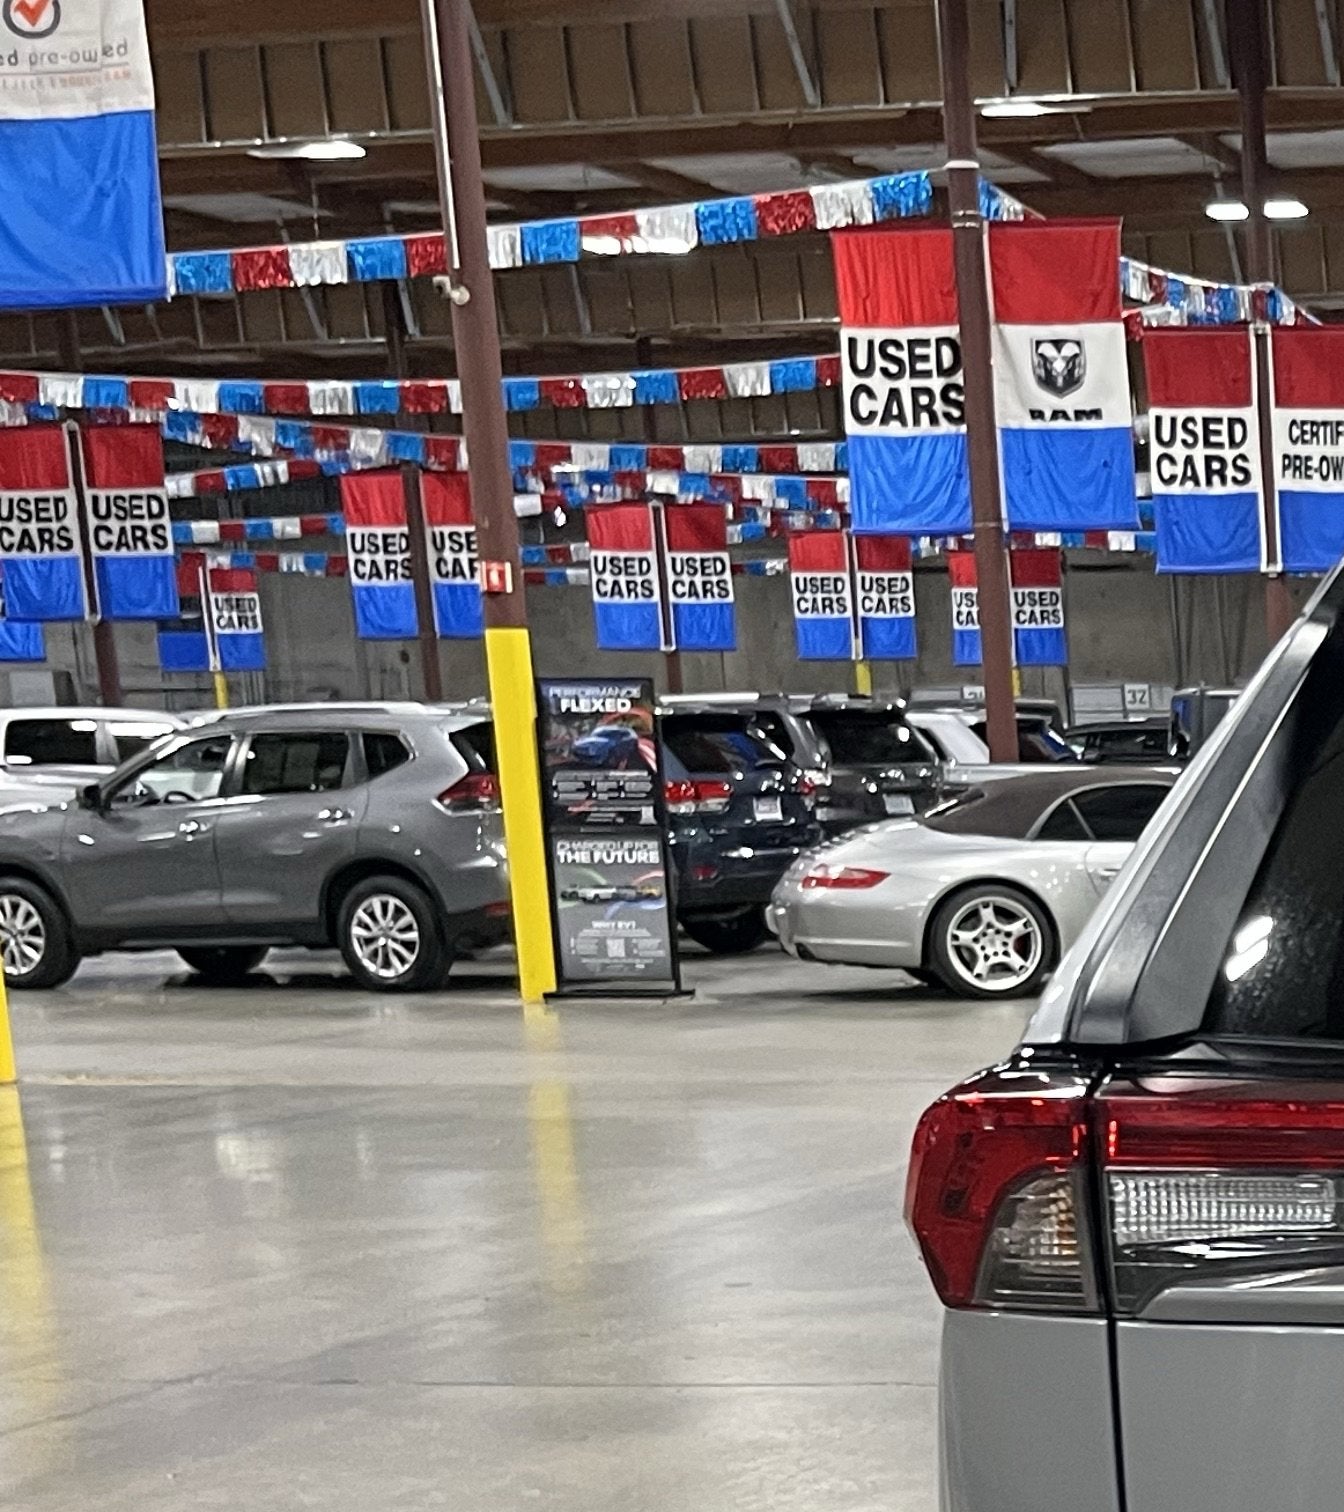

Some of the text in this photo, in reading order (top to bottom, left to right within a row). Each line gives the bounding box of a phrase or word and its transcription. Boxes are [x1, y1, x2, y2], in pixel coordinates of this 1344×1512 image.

[848, 336, 962, 380] USED
[850, 384, 965, 427] CARS
[1029, 408, 1103, 421] RAM
[1155, 415, 1248, 449] USED
[1156, 453, 1252, 487] CARS
[0, 496, 68, 523] USED
[92, 495, 165, 521] USED
[0, 526, 74, 553] CARS
[94, 524, 169, 550] CARS
[350, 532, 411, 555] USED
[432, 531, 477, 553] USE
[353, 557, 412, 580] CARS
[593, 556, 651, 576] USED
[671, 556, 726, 576] USED
[596, 579, 654, 598] CARS
[672, 579, 730, 598] CARS
[795, 576, 845, 594] USED
[861, 576, 910, 594] USED
[797, 596, 848, 614] CARS
[861, 596, 912, 614] CARS
[954, 592, 975, 608] US
[1014, 591, 1059, 607] USED
[956, 610, 976, 626] CA
[1015, 609, 1061, 625] CARS
[561, 698, 631, 713] FLEXED
[1127, 689, 1148, 705] 32
[557, 851, 660, 863] THE FUTURE
